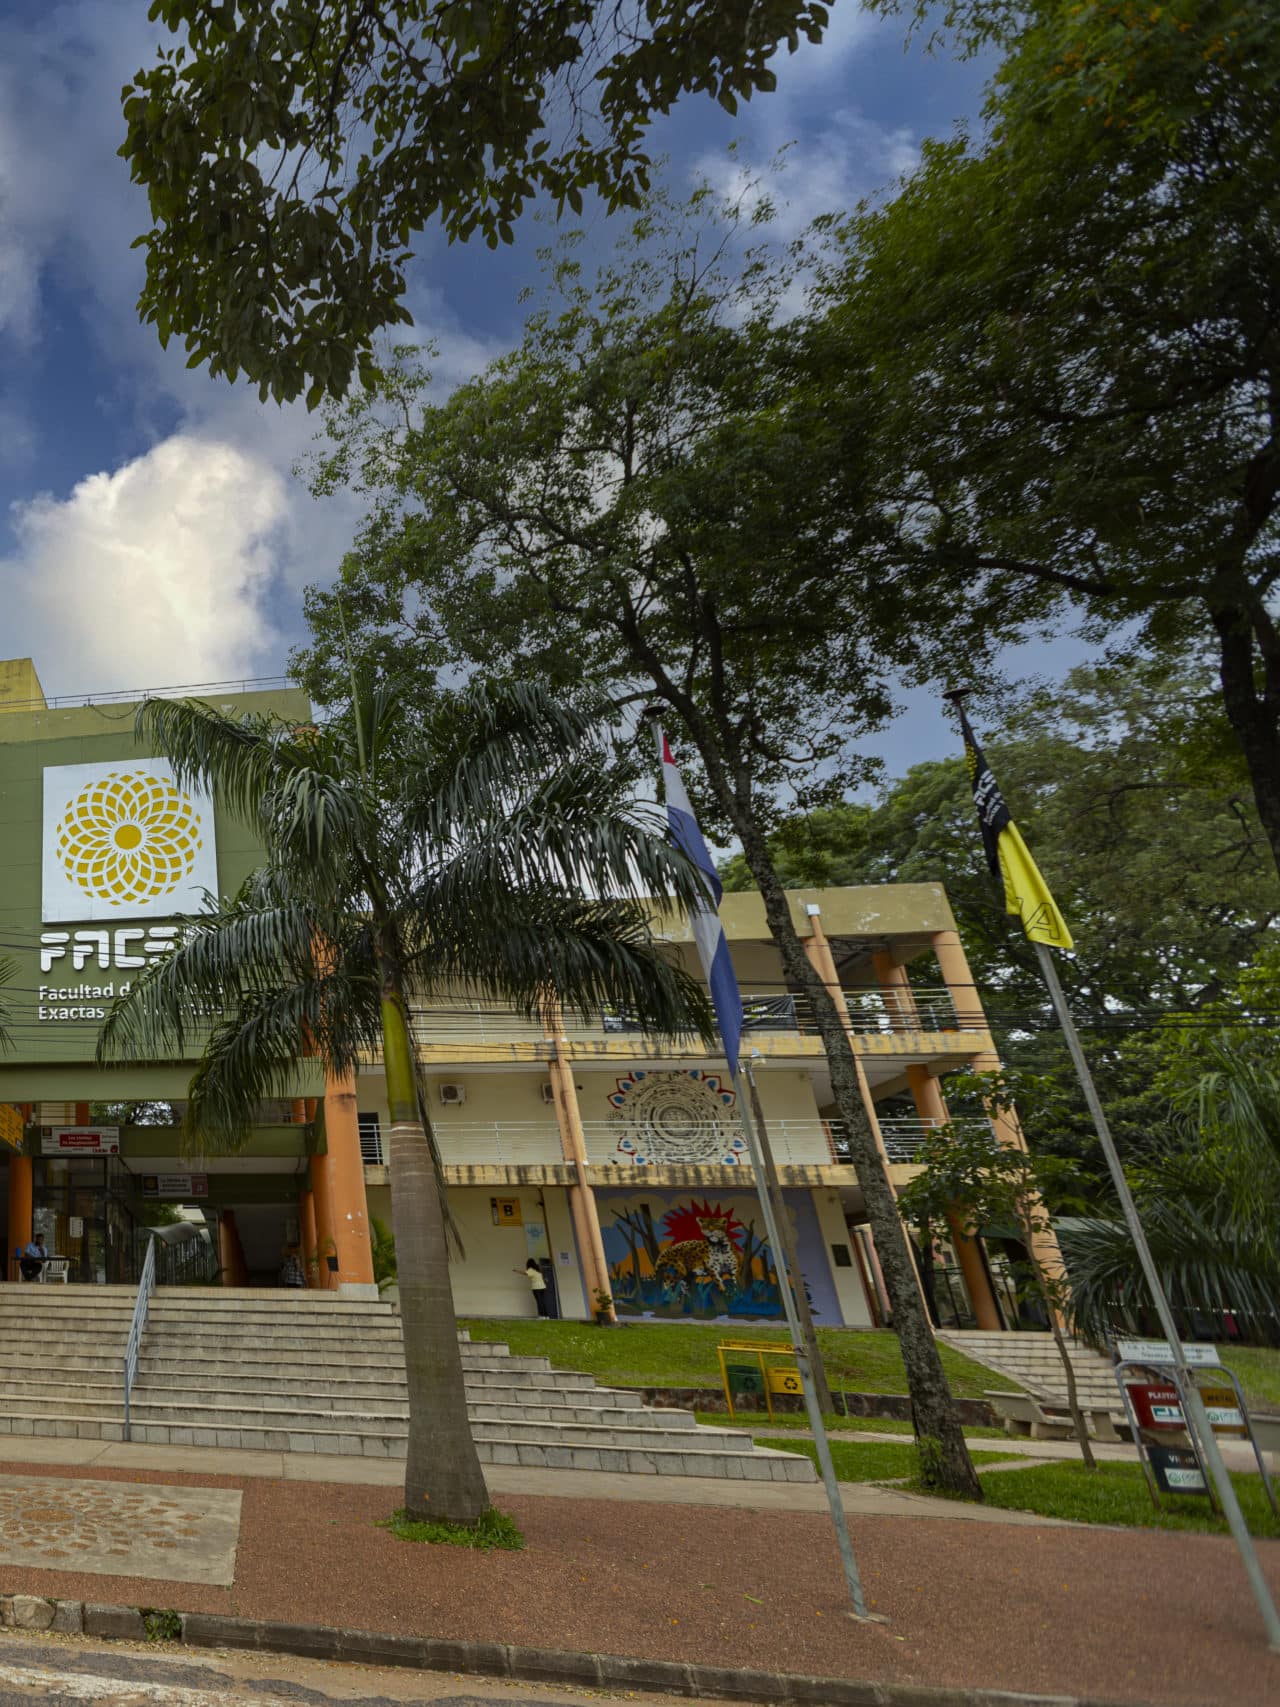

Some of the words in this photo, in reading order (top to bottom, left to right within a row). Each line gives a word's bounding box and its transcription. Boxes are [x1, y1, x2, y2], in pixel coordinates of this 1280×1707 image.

[40, 926, 220, 973] FACE
[39, 982, 114, 1001] Facultad
[38, 1005, 105, 1021] Exactas
